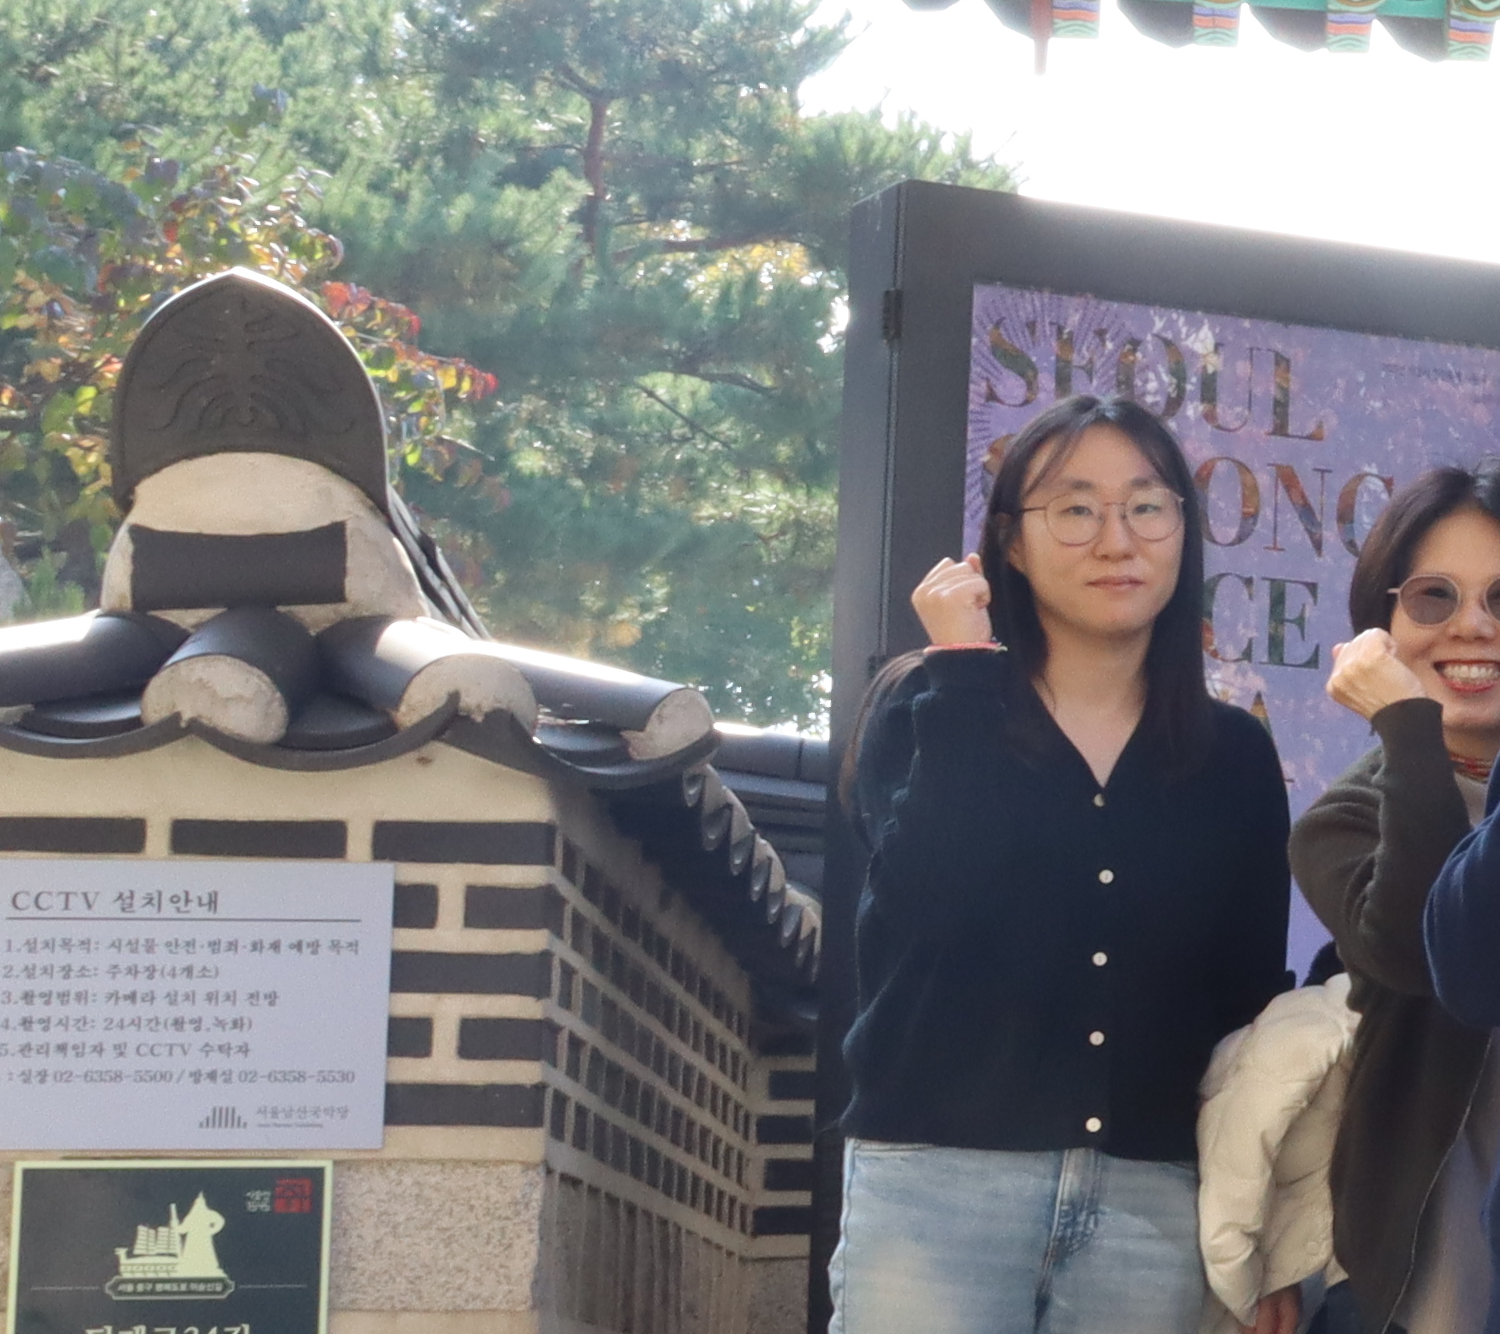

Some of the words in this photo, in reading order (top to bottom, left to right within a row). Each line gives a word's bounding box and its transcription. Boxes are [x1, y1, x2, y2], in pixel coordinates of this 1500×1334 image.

[984, 317, 1325, 442] SEOUL
[11, 891, 101, 911] CCTV
[112, 889, 221, 914] 설치안내
[327, 938, 360, 956] 목적
[165, 990, 197, 1006] 설치
[204, 990, 237, 1007] 위치
[245, 990, 280, 1007] 전방
[112, 1042, 128, 1059] 및
[136, 1043, 191, 1057] CCTV
[53, 1070, 173, 1084] 02-6358-5500
